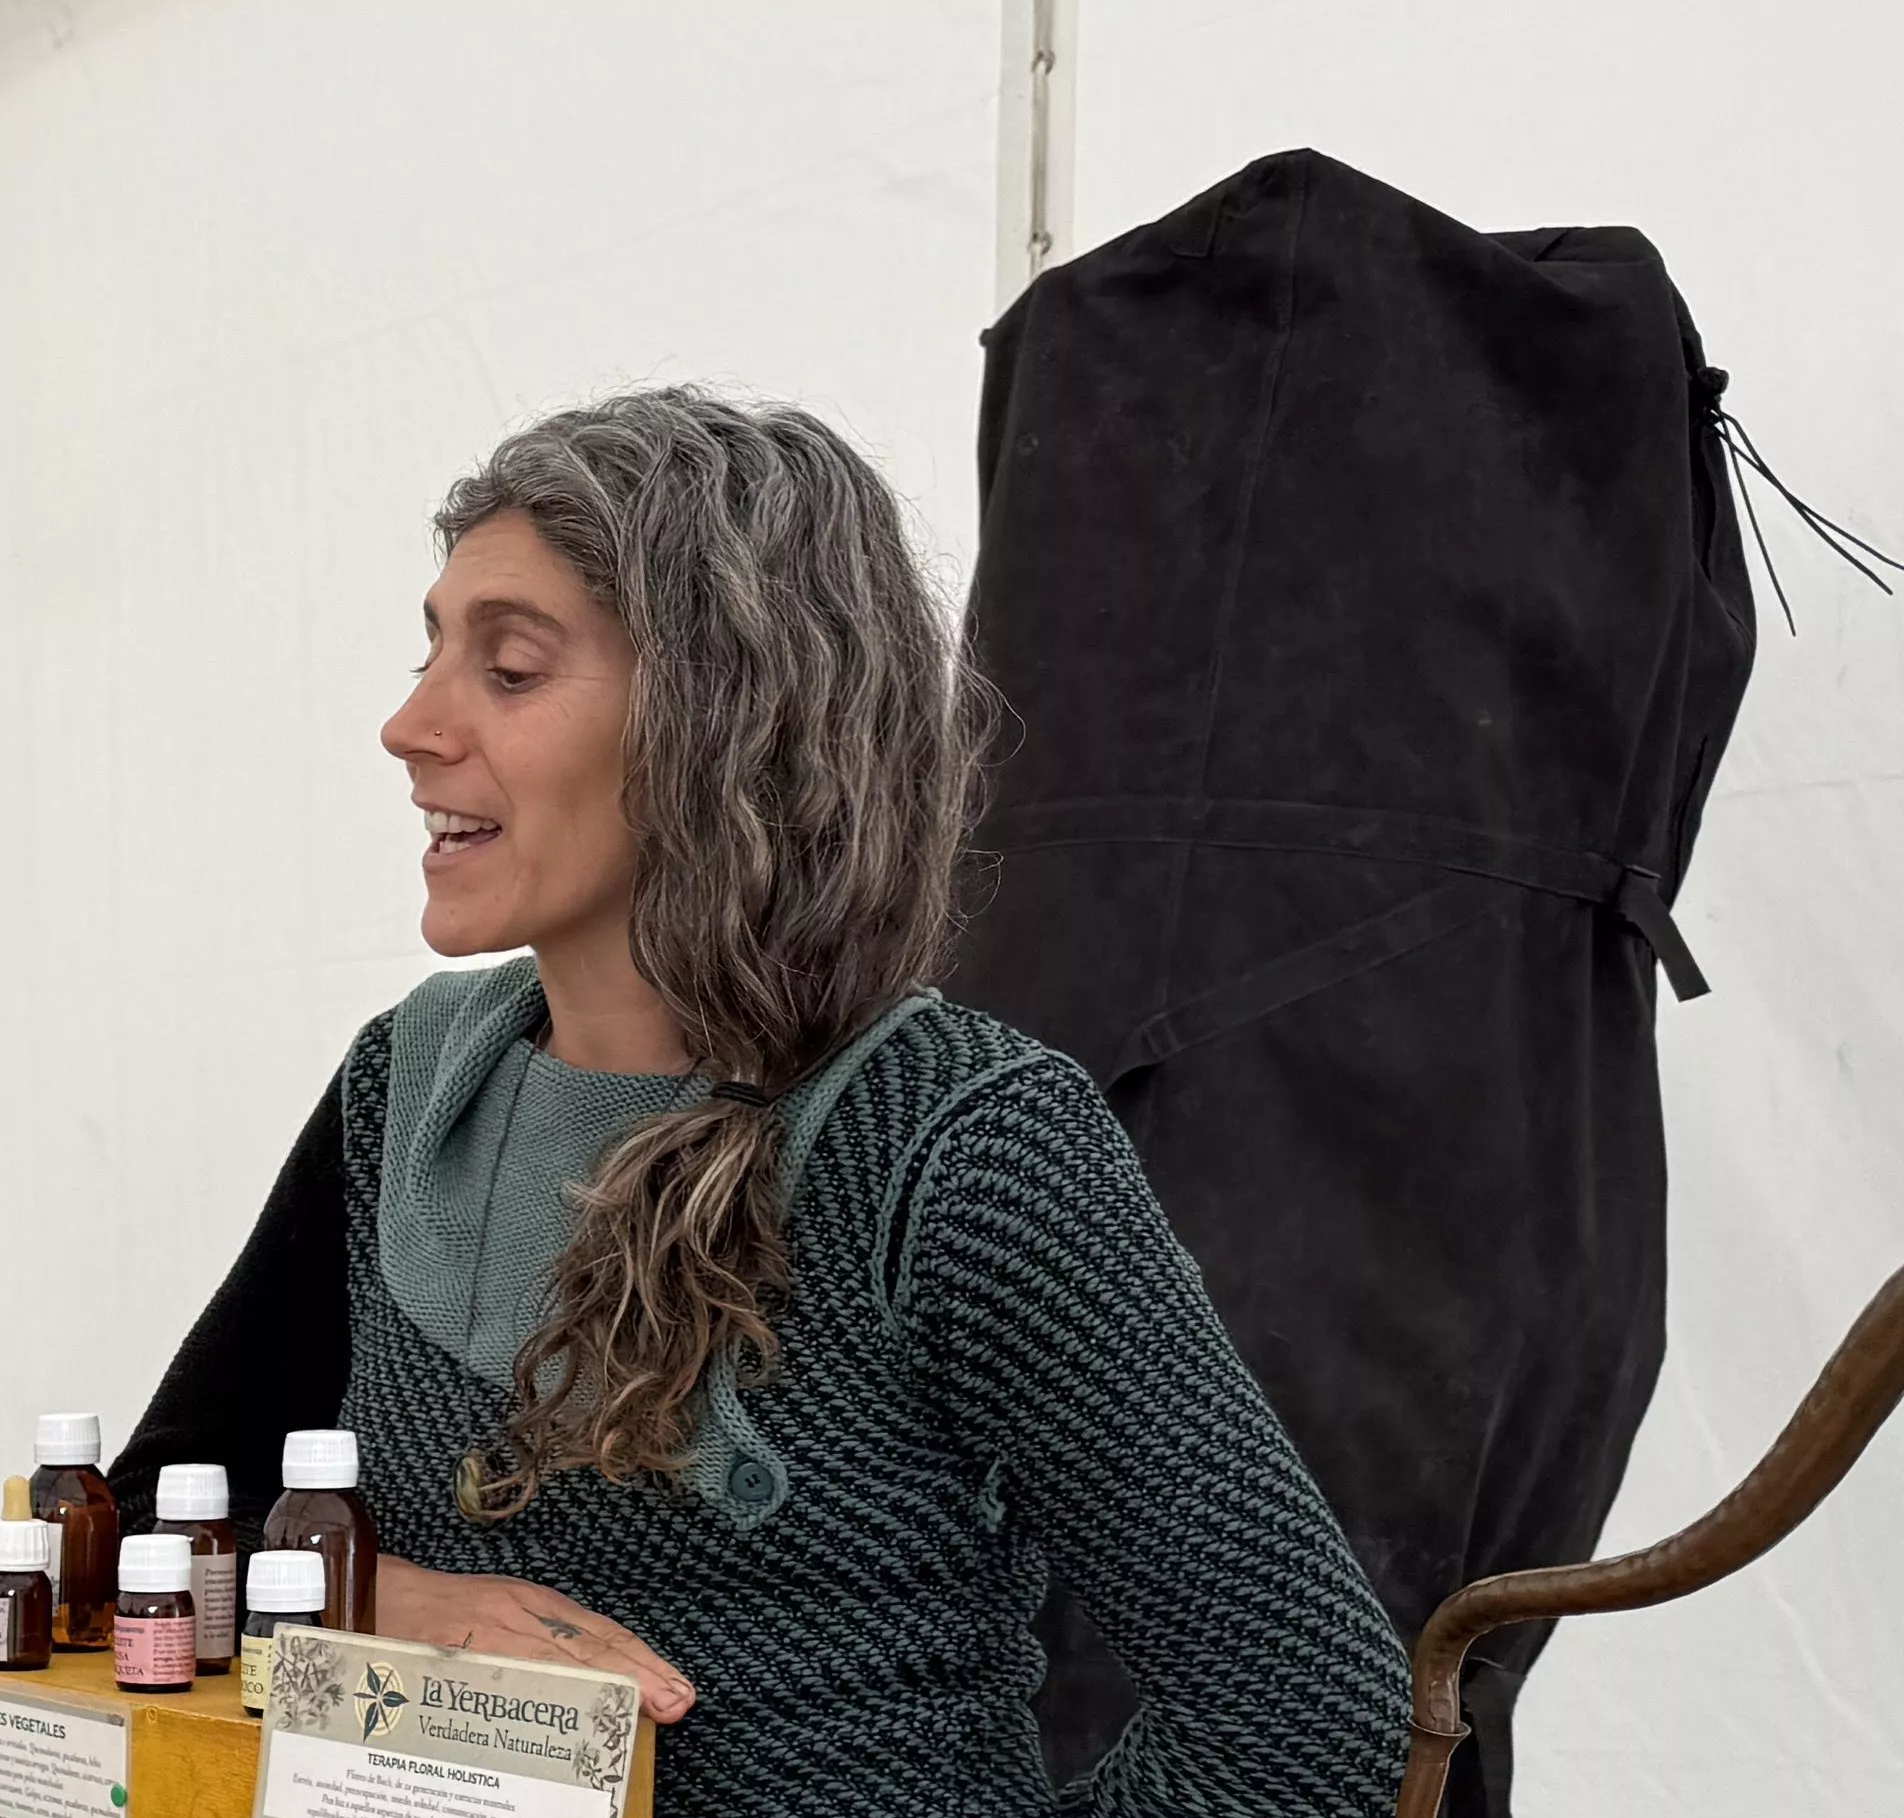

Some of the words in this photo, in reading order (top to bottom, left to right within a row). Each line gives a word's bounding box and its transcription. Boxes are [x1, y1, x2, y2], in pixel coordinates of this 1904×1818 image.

[420, 1676, 443, 1708] La
[8, 1714, 66, 1739] VEGETALES
[419, 1715, 489, 1747] Verdadera
[493, 1728, 572, 1761] Naturaleza
[368, 1753, 407, 1771] TERAPIA
[408, 1762, 445, 1779] FLORAL
[447, 1768, 501, 1789] HOLISTICA
